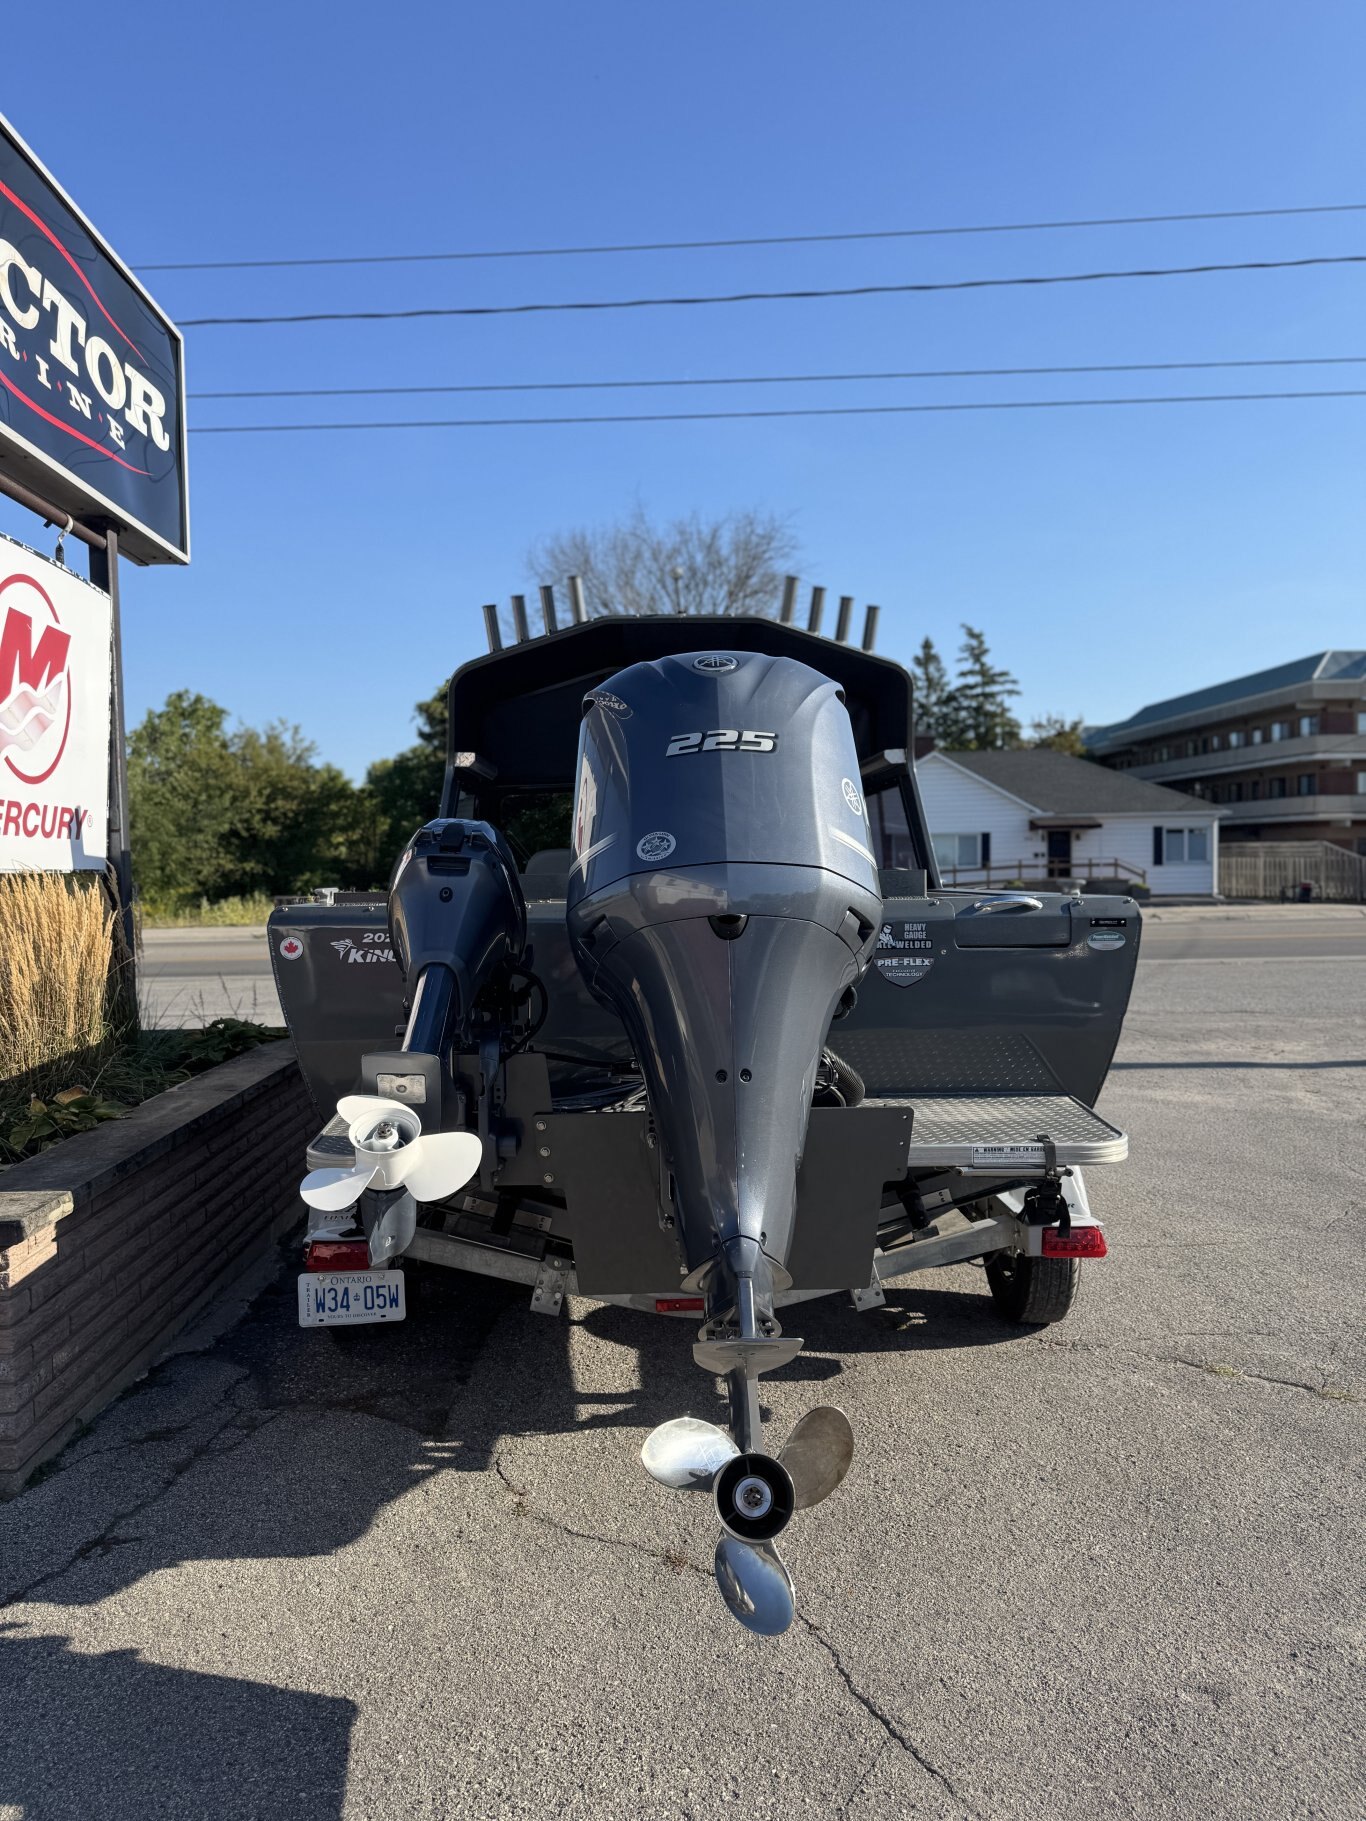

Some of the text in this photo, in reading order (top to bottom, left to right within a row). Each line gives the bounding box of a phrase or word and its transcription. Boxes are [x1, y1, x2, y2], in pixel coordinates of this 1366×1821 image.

[665, 729, 777, 757] 225
[904, 923, 926, 931] HEAVY
[904, 931, 927, 939] GAUGE
[895, 940, 932, 949] WELDED
[877, 958, 931, 967] PRE-FLEX
[330, 1275, 372, 1286] ONTARIO
[315, 1284, 399, 1314] W34 05W
